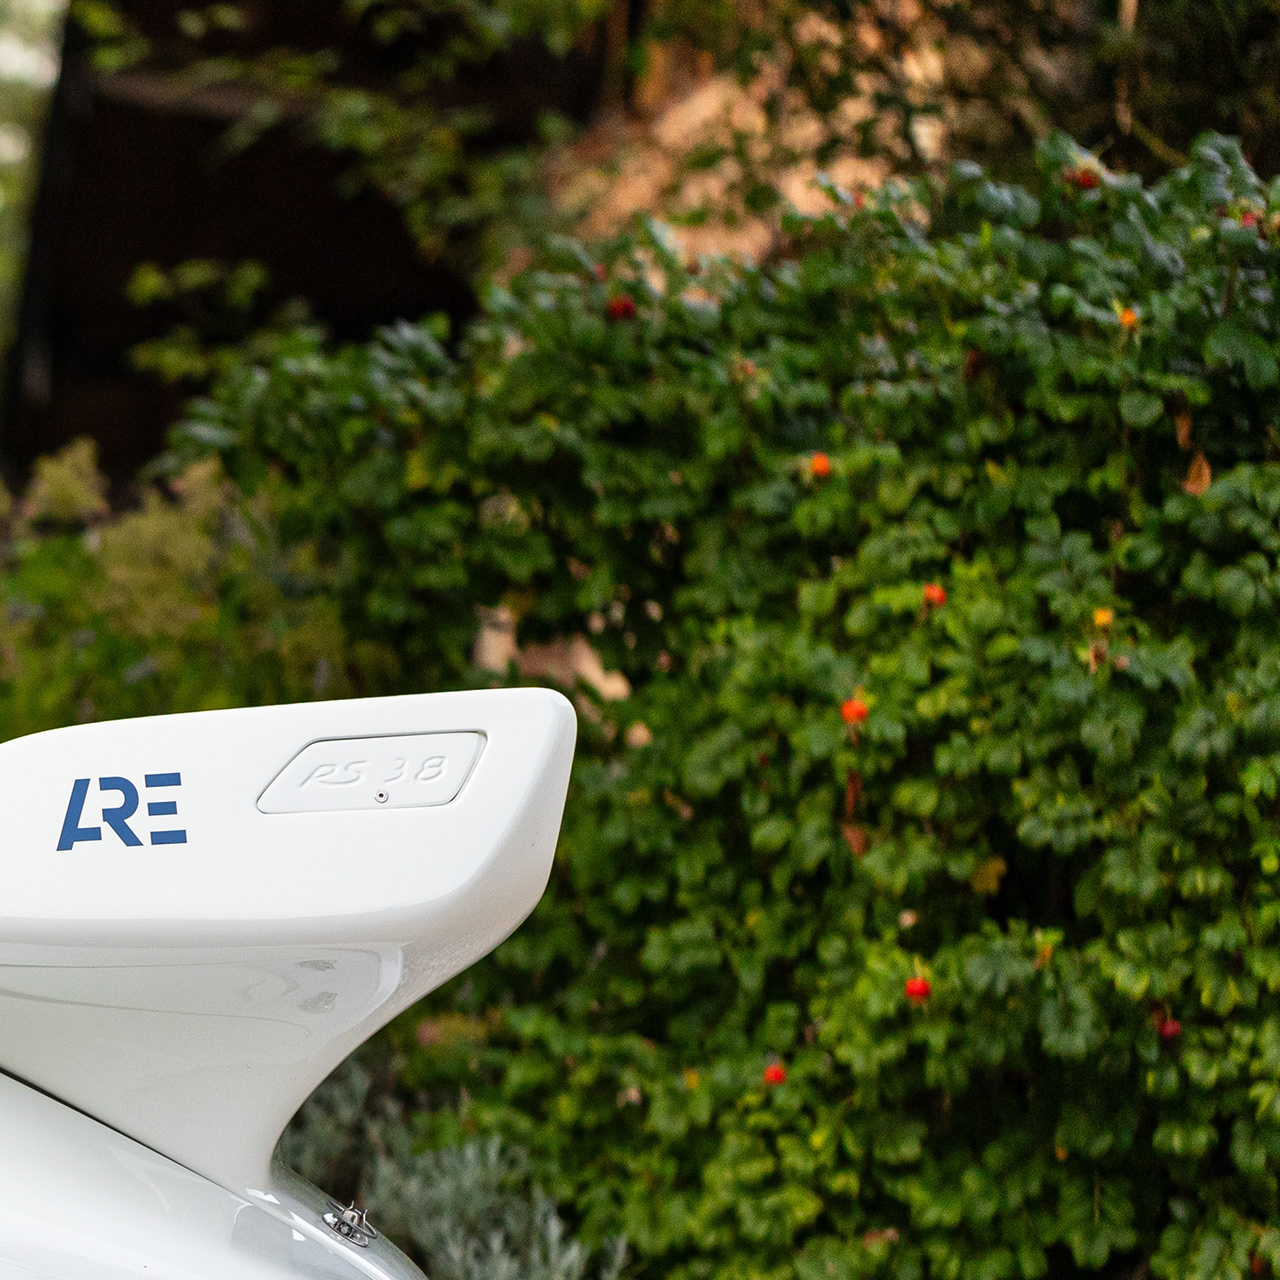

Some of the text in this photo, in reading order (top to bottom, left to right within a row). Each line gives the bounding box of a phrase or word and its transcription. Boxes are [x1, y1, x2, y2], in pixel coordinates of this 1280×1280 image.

[299, 755, 447, 789] RS 3.8
[56, 772, 188, 851] ARE
